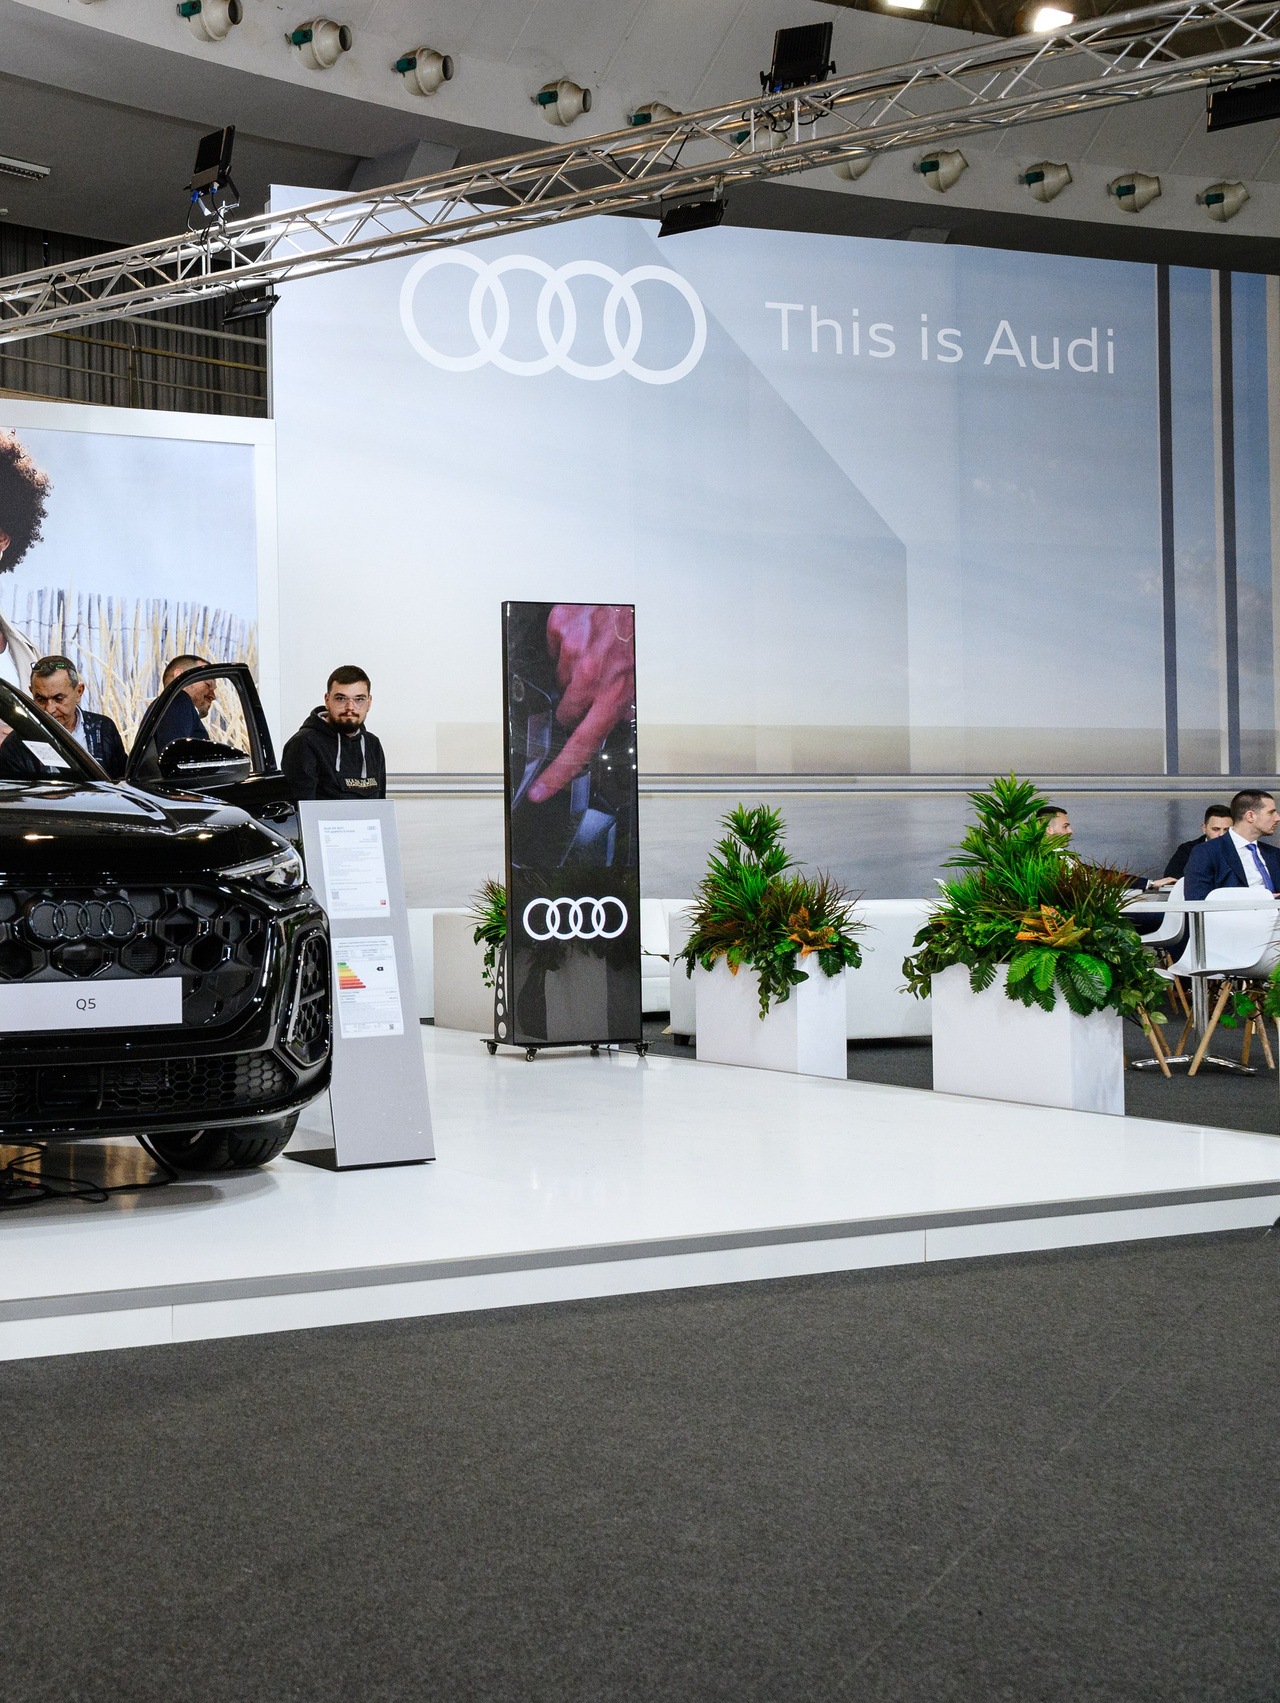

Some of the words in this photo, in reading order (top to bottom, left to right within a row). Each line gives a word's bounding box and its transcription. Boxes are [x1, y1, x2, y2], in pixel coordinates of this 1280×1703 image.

[764, 301, 896, 358] This
[921, 313, 964, 363] is
[983, 319, 1115, 374] Audi
[76, 998, 97, 1011] Q5
